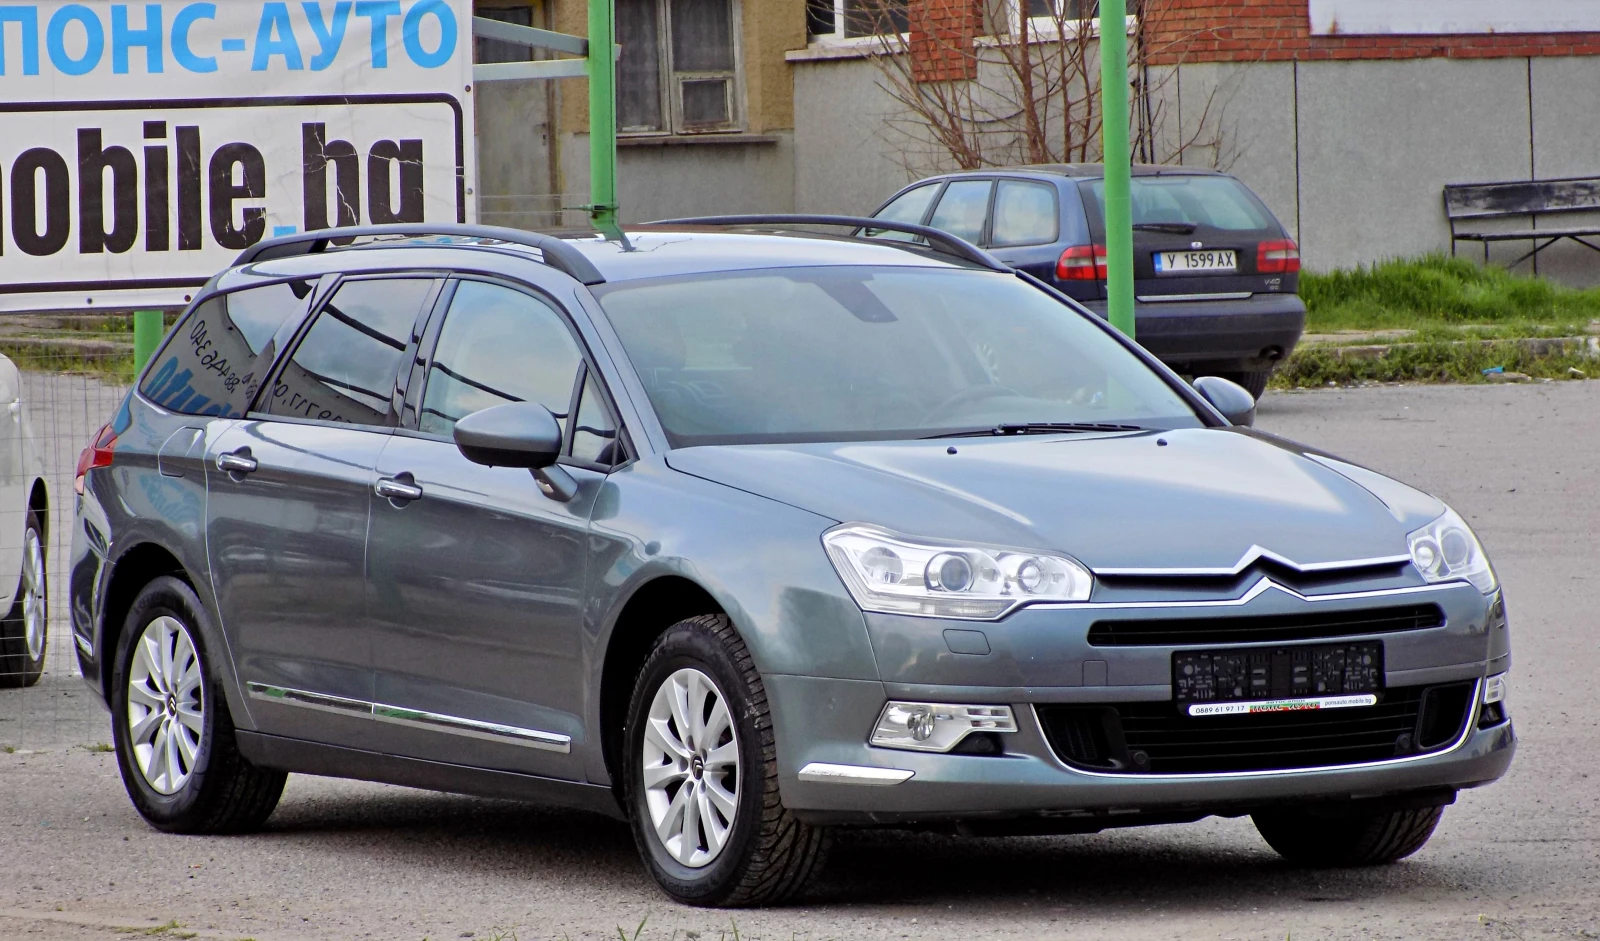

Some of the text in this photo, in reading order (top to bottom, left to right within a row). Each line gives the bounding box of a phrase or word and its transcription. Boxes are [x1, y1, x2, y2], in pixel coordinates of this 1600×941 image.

[0, 121, 425, 257] obile.bg
[1184, 252, 1214, 269] 1599
[1324, 698, 1372, 707] ponsauto.mobile.bg
[1195, 706, 1213, 714] 0889
